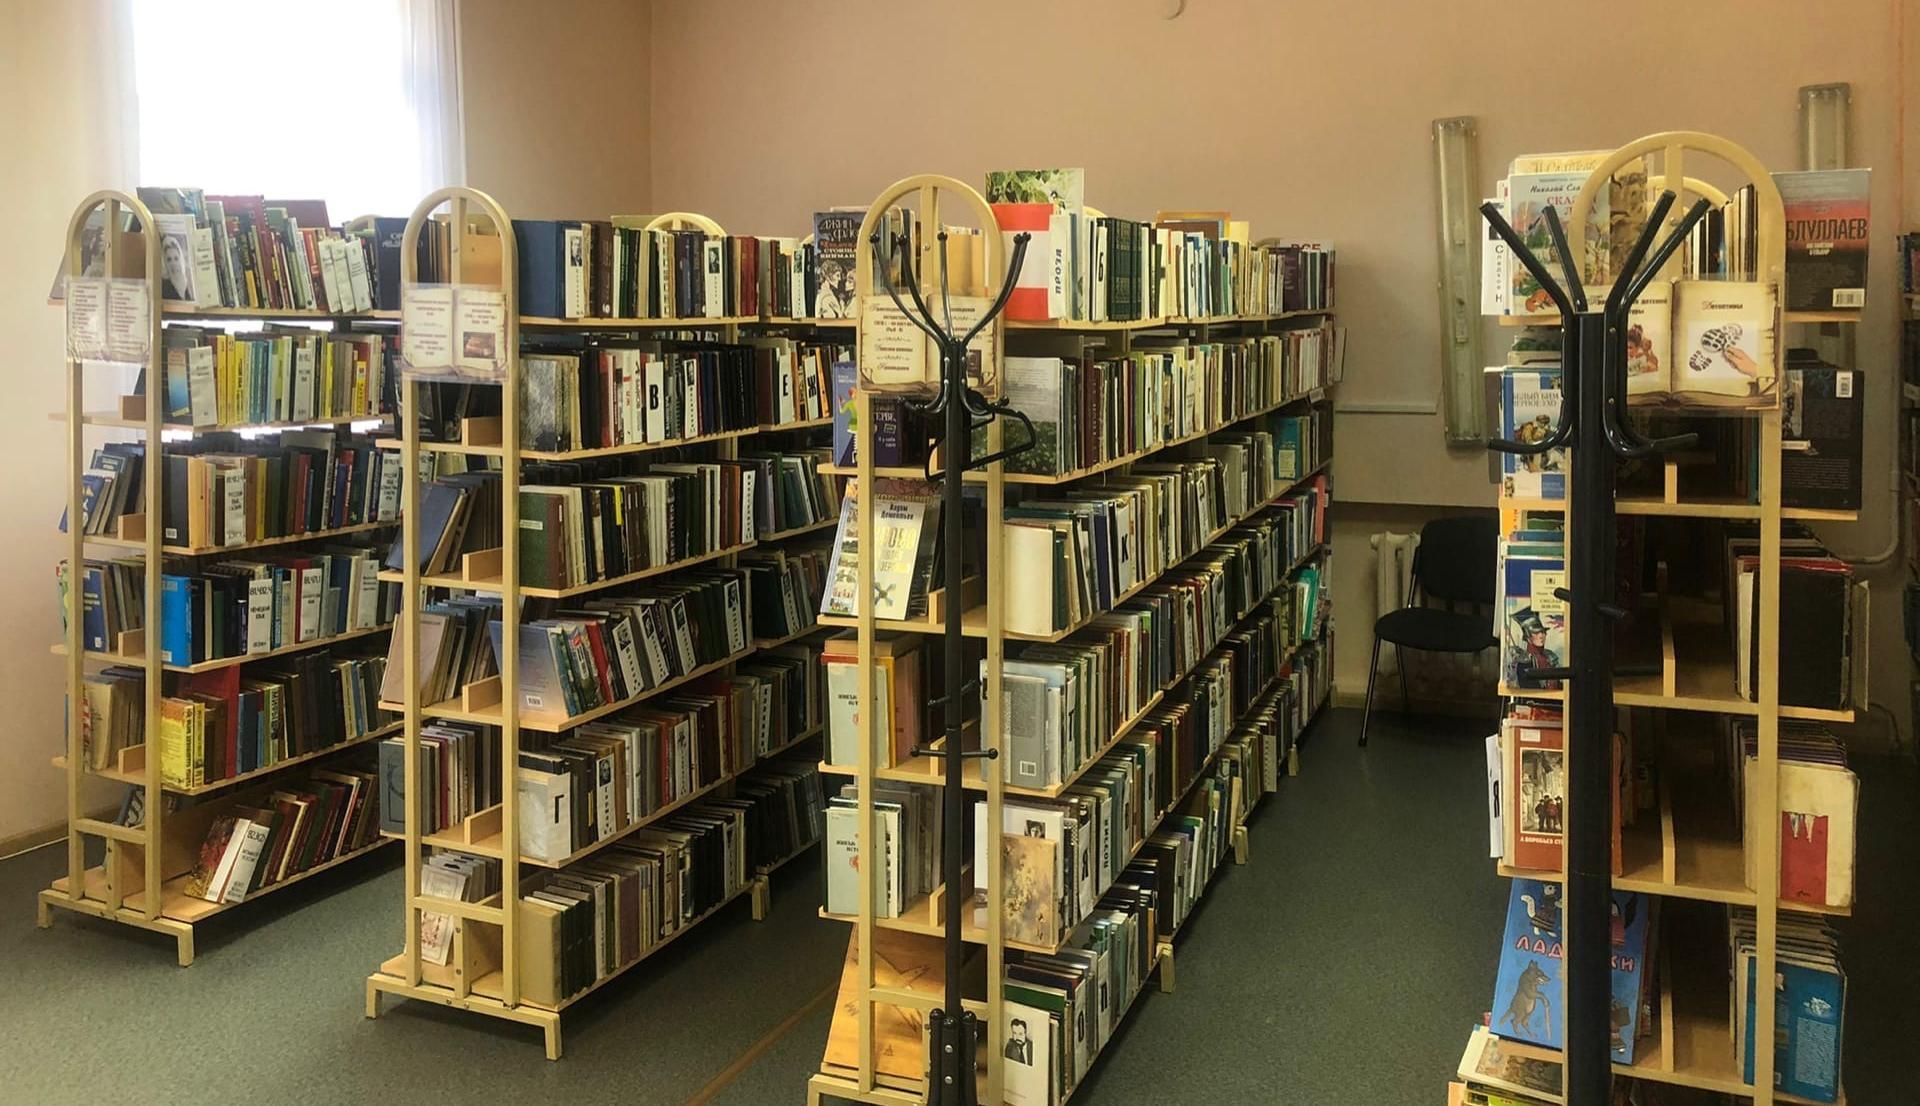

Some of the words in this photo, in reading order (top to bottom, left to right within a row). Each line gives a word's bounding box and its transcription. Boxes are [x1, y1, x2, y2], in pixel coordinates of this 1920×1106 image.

[1702, 301, 1743, 310] Детективы
[649, 384, 659, 411] В
[782, 374, 789, 397] Е
[807, 374, 817, 398] Ж
[1121, 533, 1128, 563] К
[554, 794, 565, 824] Г
[1493, 780, 1501, 819] Я
